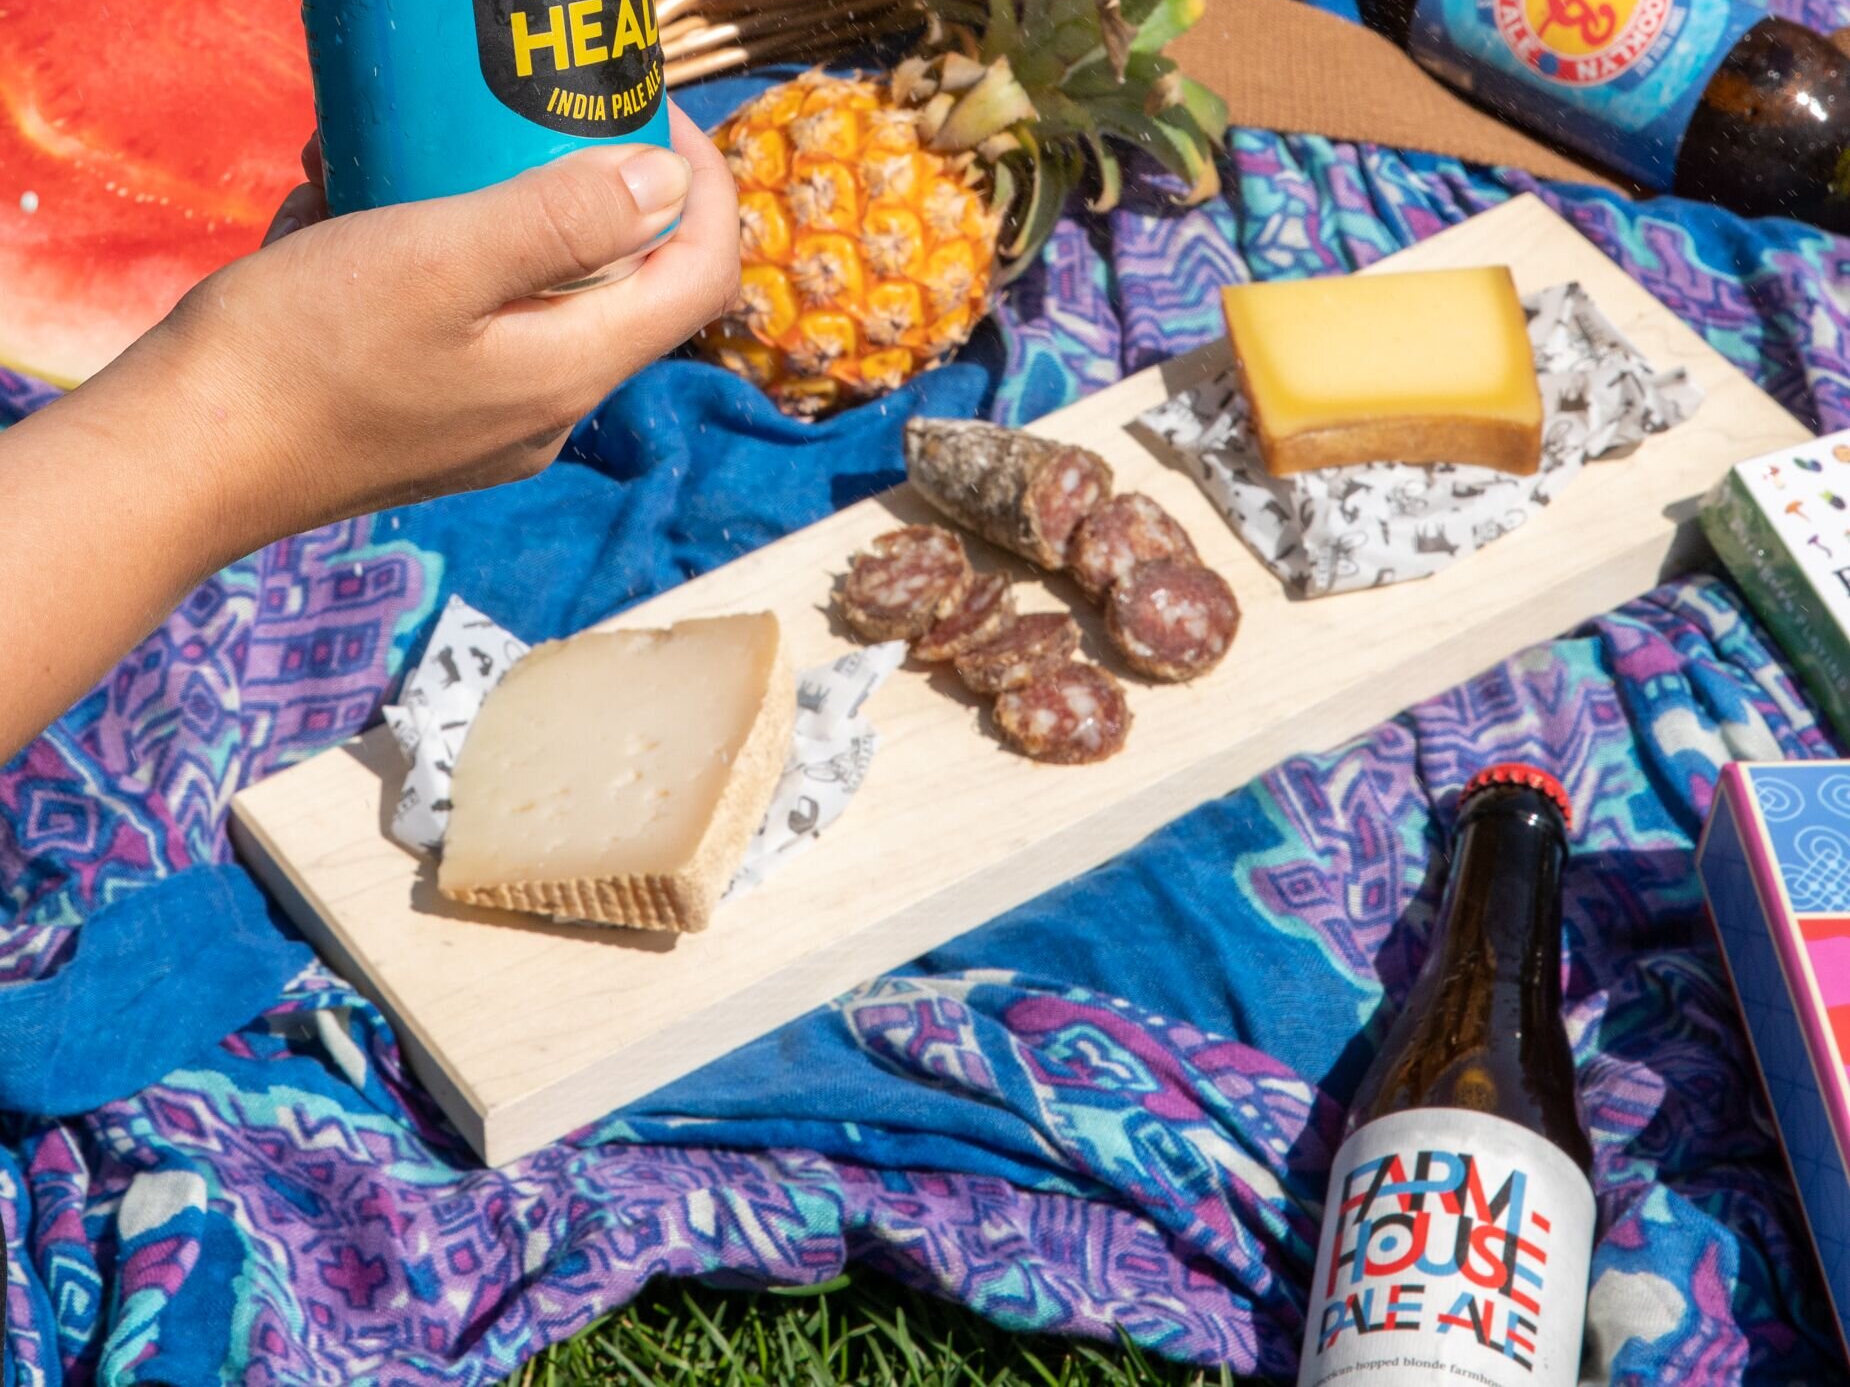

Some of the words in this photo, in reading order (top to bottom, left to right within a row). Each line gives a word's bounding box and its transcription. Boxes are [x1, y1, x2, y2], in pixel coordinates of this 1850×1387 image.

[1501, 4, 1537, 60] ALE
[547, 87, 606, 121] INDIA
[612, 82, 647, 119] PALE
[646, 61, 662, 100] ALE
[1326, 1212, 1547, 1317] HOUSE
[1317, 1284, 1426, 1355] PALE
[1436, 1291, 1538, 1373] ALE
[1403, 1357, 1446, 1371] blonde
